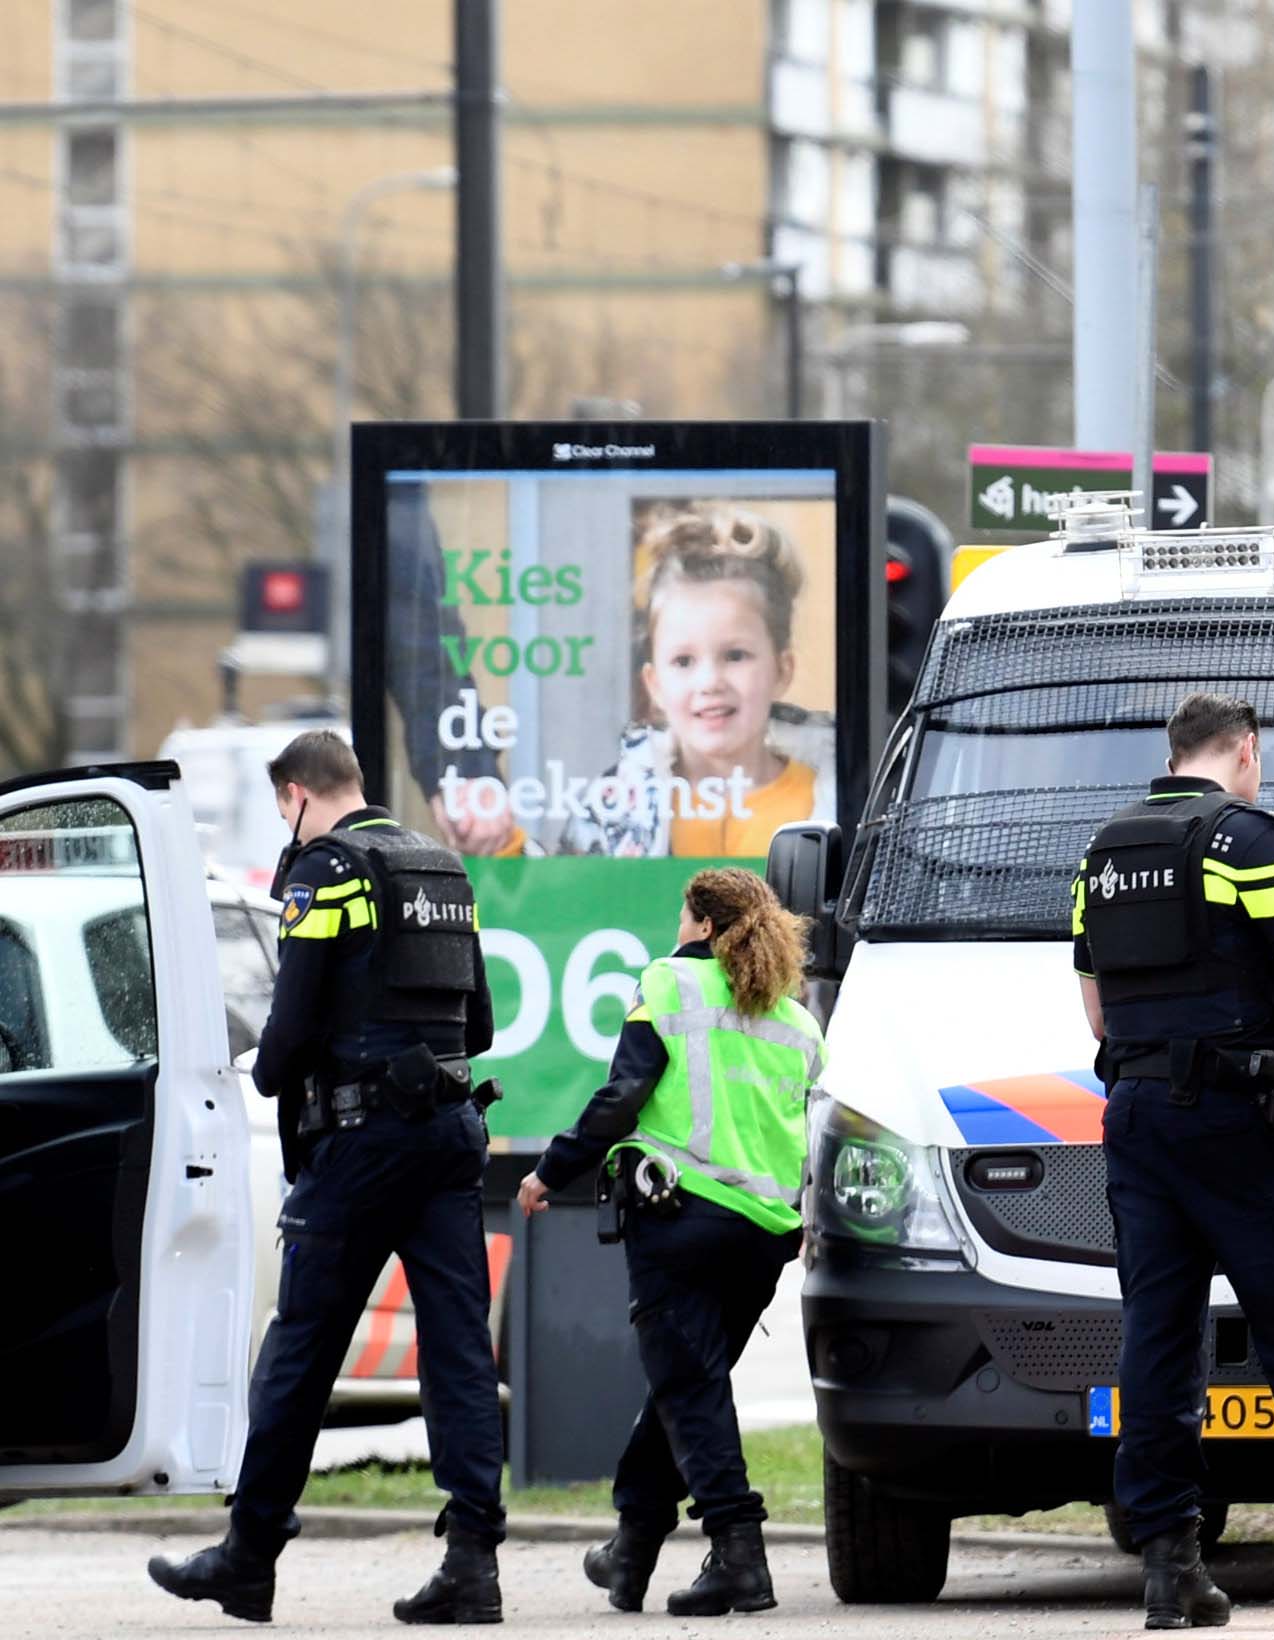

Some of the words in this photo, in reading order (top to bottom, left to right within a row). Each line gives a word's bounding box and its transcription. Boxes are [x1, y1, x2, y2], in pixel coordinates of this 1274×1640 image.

[571, 443, 603, 459] Clear
[604, 443, 656, 459] Channel
[441, 548, 584, 606] Kies
[441, 636, 594, 677] voor
[438, 688, 519, 750] de
[439, 760, 754, 820] toekomst
[1089, 858, 1175, 900] POLITIE
[402, 886, 473, 927] POLITIE
[1021, 1320, 1056, 1331] VDL
[1093, 1416, 1109, 1427] NL
